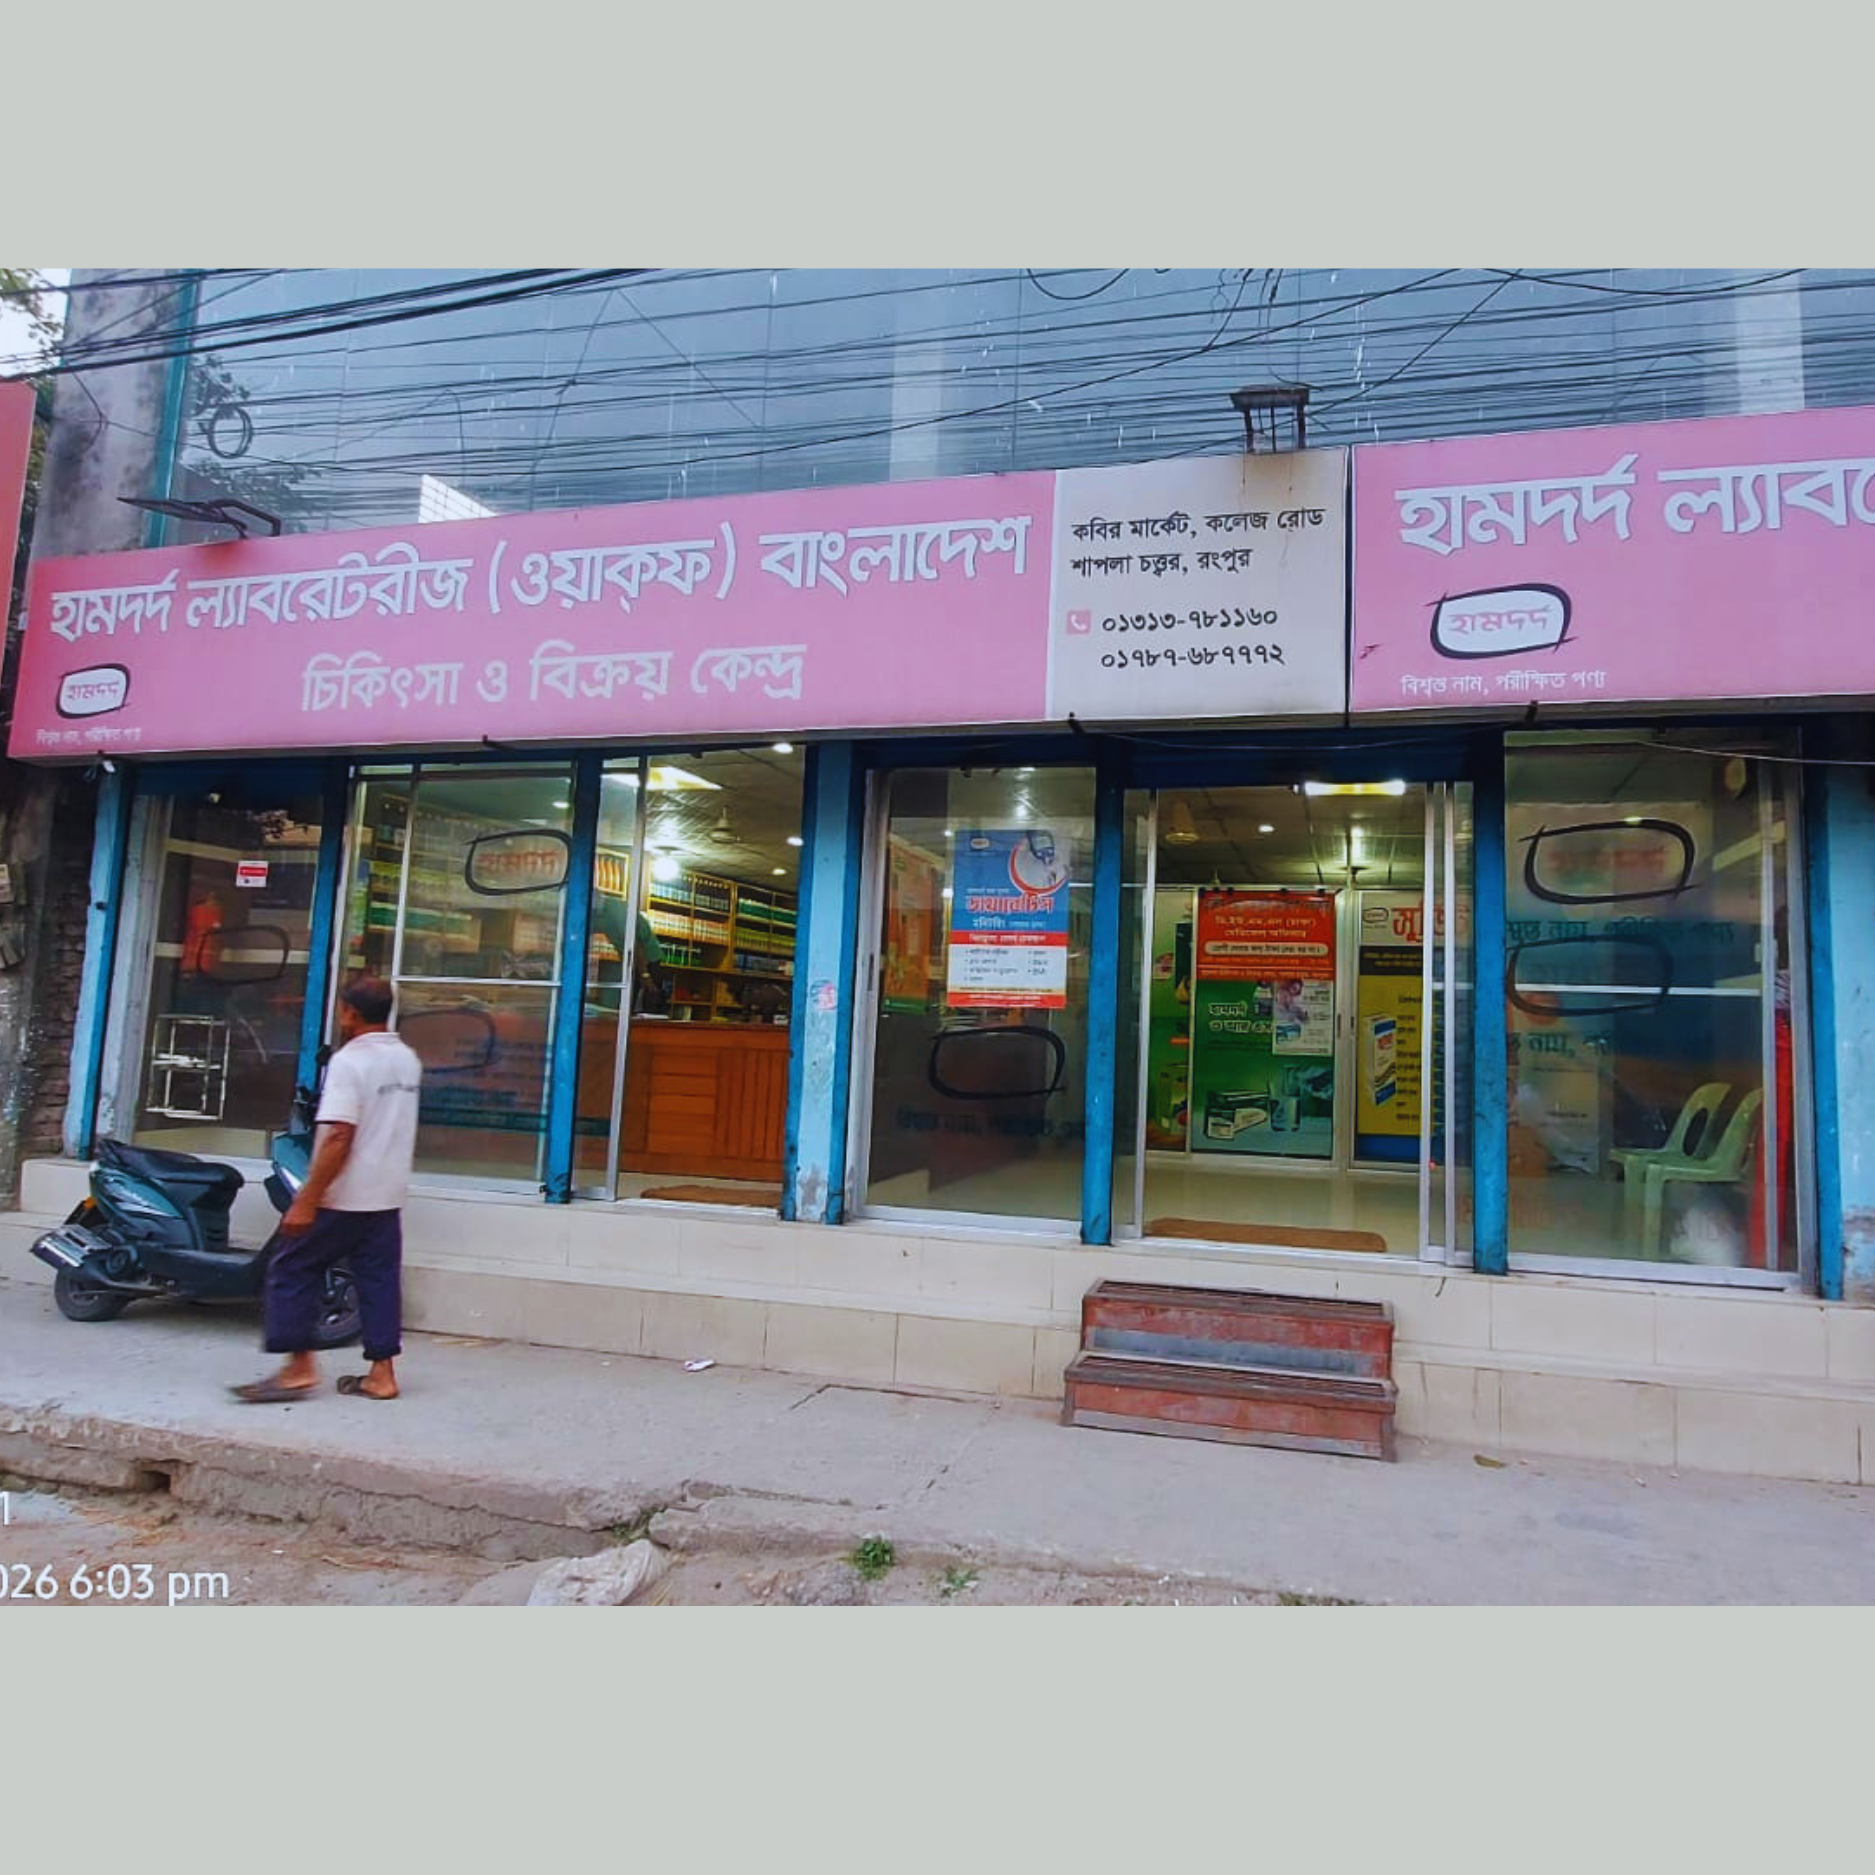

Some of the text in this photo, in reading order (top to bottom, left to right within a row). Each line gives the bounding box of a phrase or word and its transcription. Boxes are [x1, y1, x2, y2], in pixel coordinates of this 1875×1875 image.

[1395, 453, 1638, 556] হামদর্দ
[1071, 508, 1326, 542] কবির মার্কেট, কলেজ রোড
[50, 570, 180, 642] হামদর্দ
[186, 541, 474, 628] ল্যাবরেটরীজ
[758, 514, 1032, 598] বাংলাদেশ
[1070, 554, 1132, 578] শাপলা
[1197, 548, 1253, 574] রংপুর
[1102, 607, 1277, 632] ০১৩১৩-৭৮১১৬০
[1447, 605, 1551, 636] হামদর্দ
[1101, 643, 1286, 669] ০১৭৮৭-৬৮৭৭৭২
[302, 638, 807, 712] চিকিৎসা ও বিক্রয় কেন্দ্র
[1401, 670, 1607, 698] বিশ্বস্ত নাম, পরীক্ষিত পণ্য
